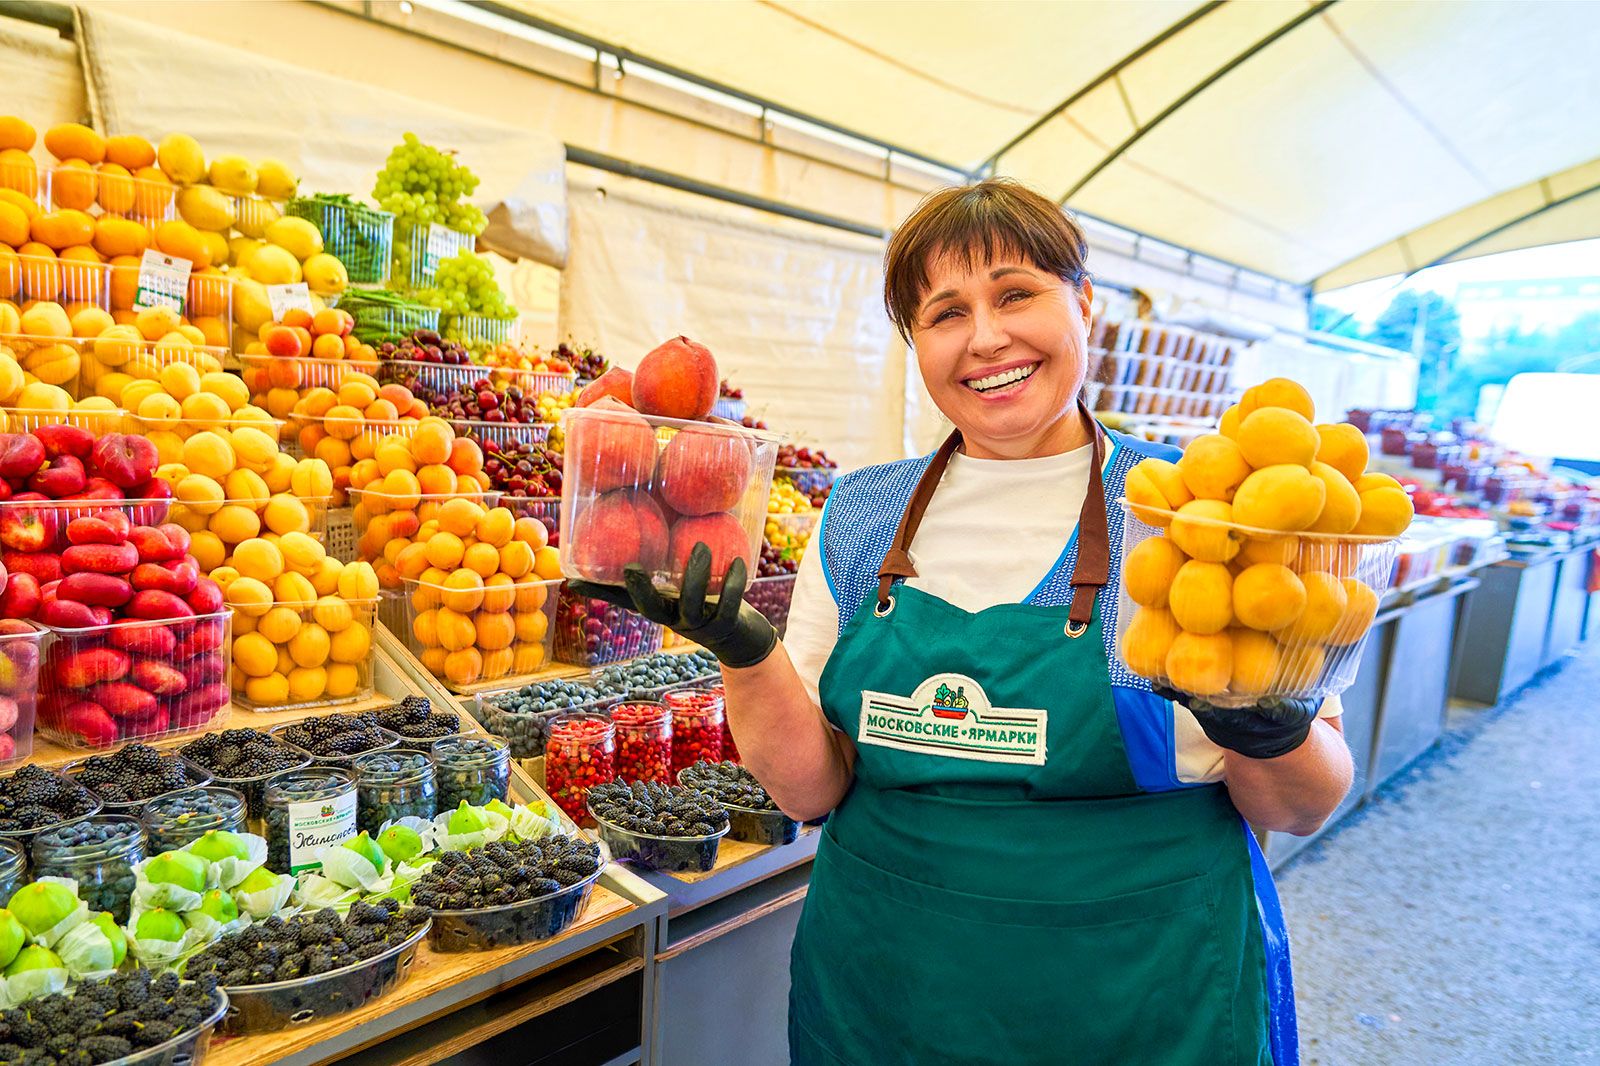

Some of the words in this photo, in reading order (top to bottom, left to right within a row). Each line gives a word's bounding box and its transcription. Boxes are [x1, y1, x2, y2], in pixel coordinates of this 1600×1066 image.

[866, 713, 959, 738] МОСКОВСКИЕ
[968, 727, 1037, 745] ЯРМАРКИ
[294, 817, 333, 827] МОСКОВСКИЕ
